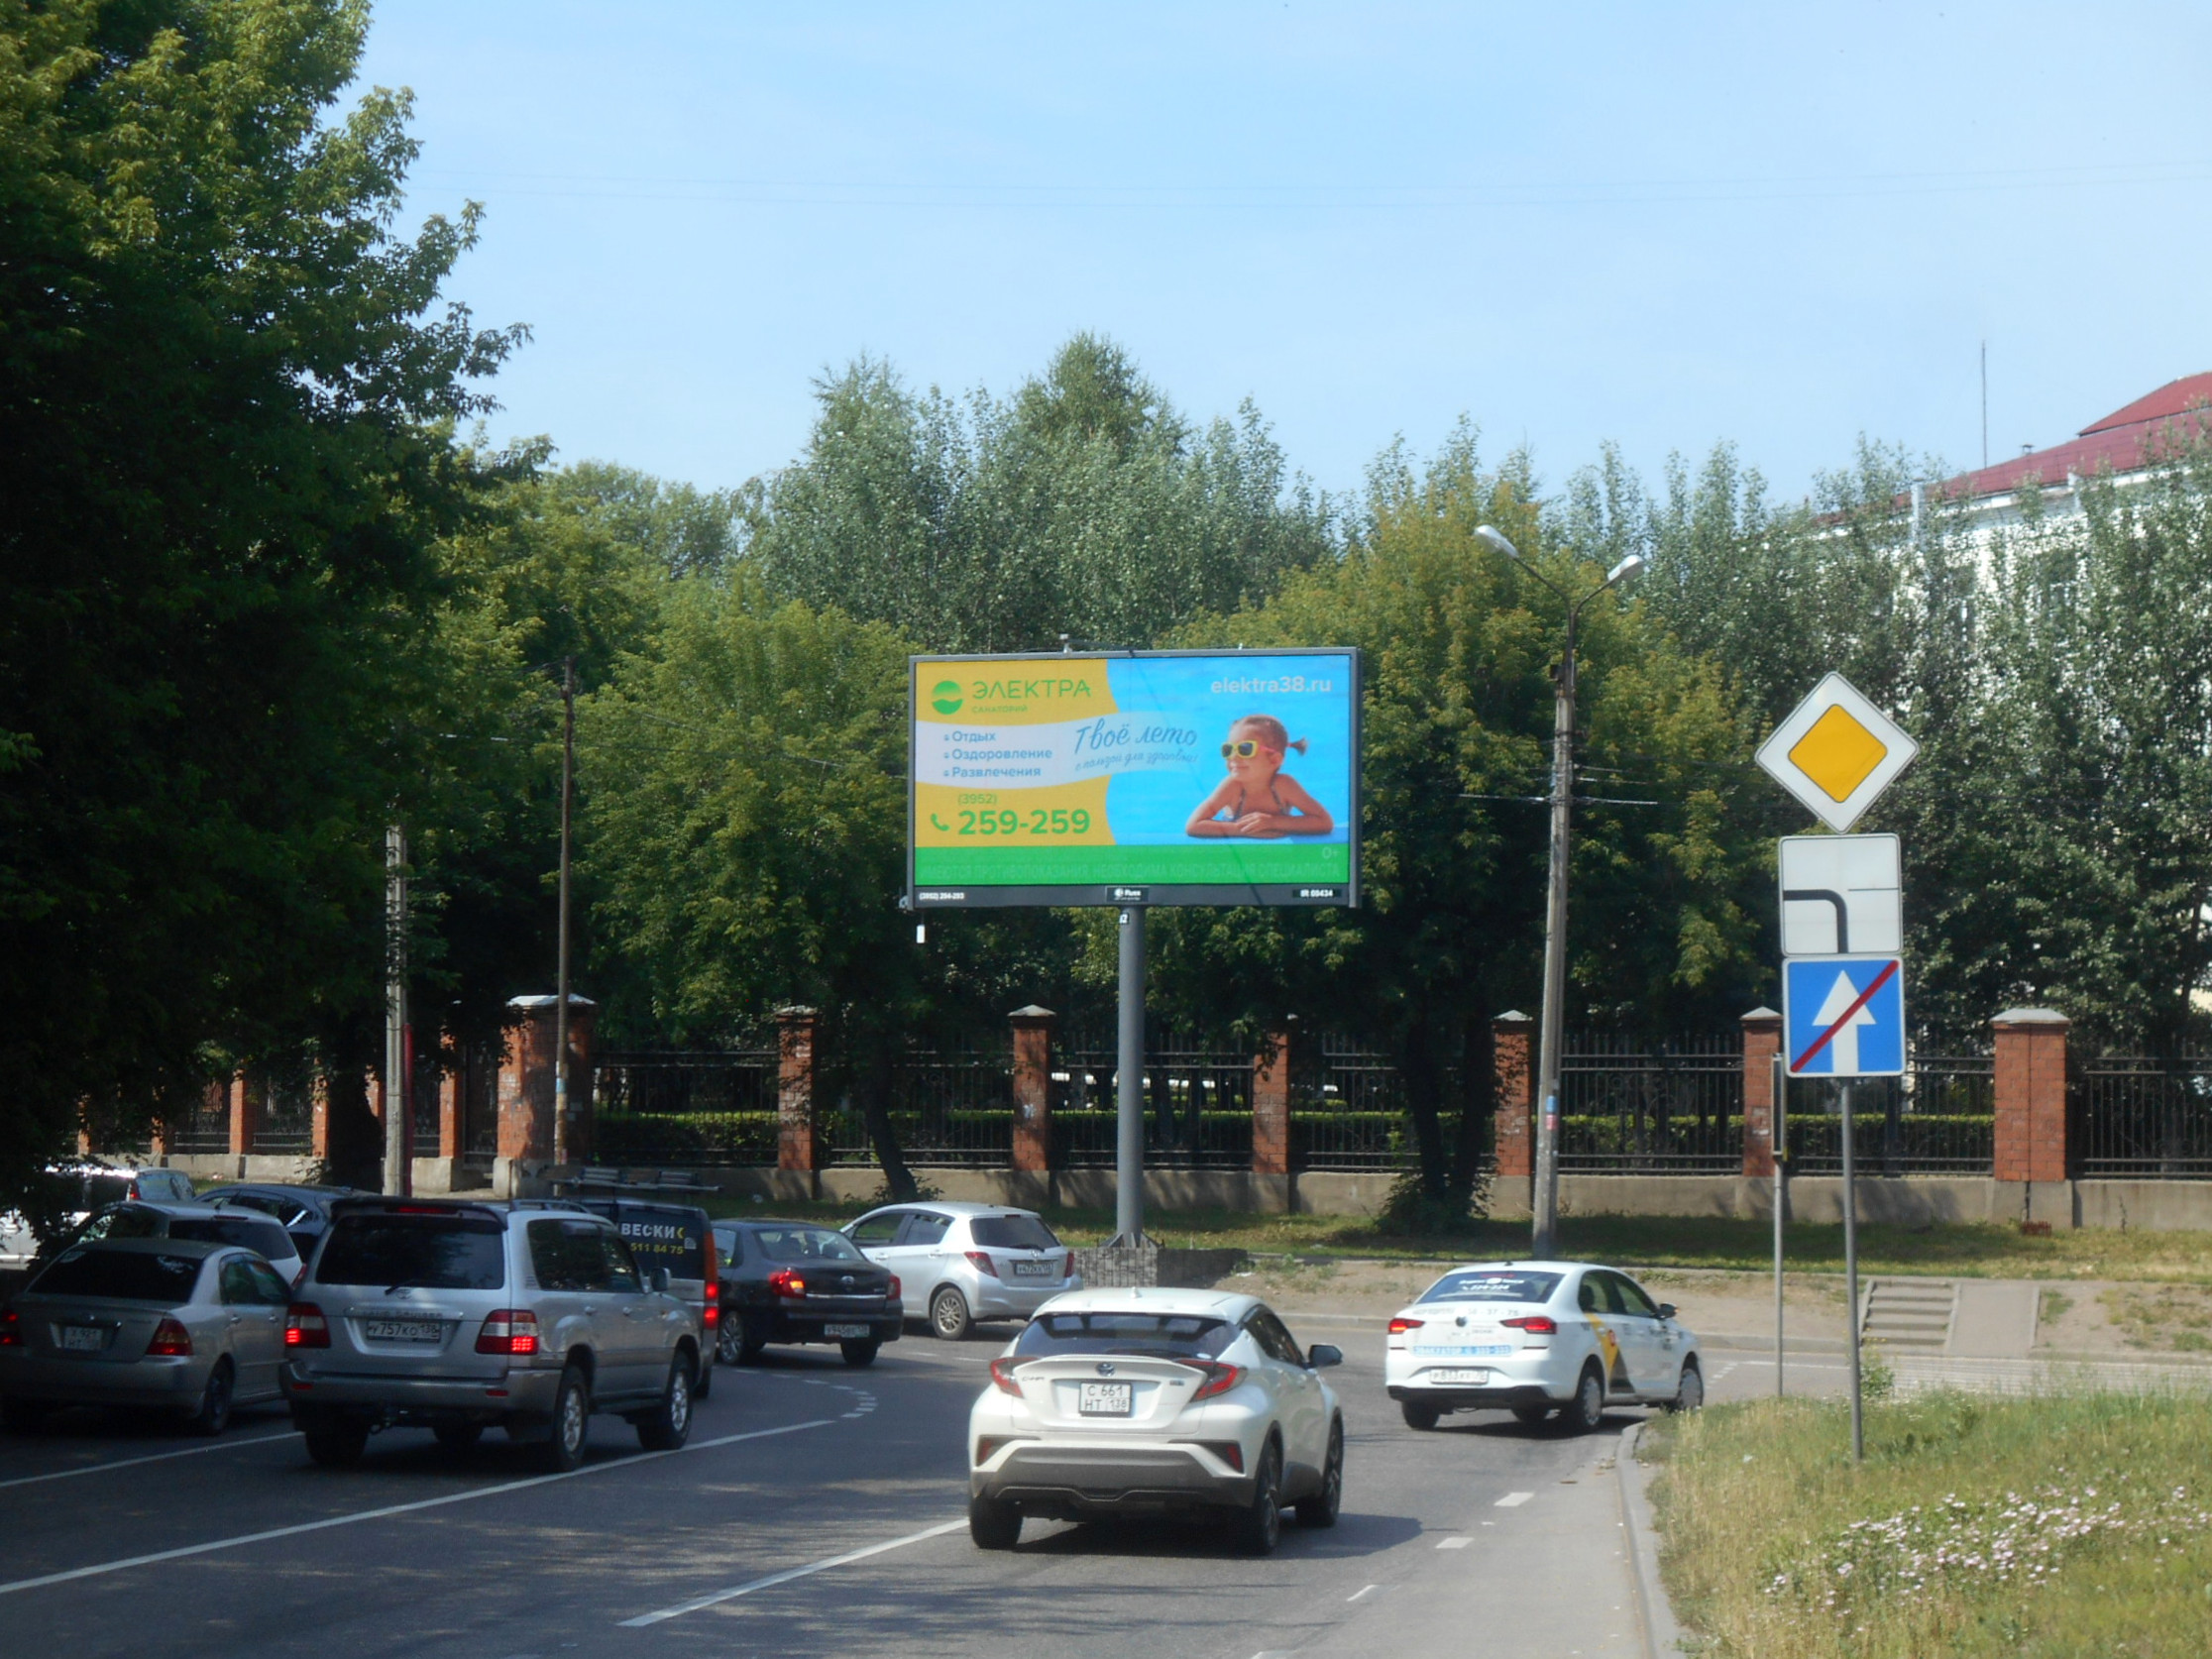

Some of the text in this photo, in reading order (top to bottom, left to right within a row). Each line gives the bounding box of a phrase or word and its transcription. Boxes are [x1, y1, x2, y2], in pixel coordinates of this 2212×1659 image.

[972, 679, 1092, 700] ЭЛЕКТРА
[1211, 676, 1332, 693] elektra38.ru
[952, 730, 996, 743] Отдых
[1073, 717, 1198, 755] Твоё лето
[951, 748, 1052, 761] Оздоровление
[951, 766, 1042, 778] Развлечения
[958, 793, 998, 805] (3952)
[958, 809, 1090, 834] 259-259
[1101, 1384, 1124, 1396] 661
[1085, 1398, 1127, 1411] НТ 138
